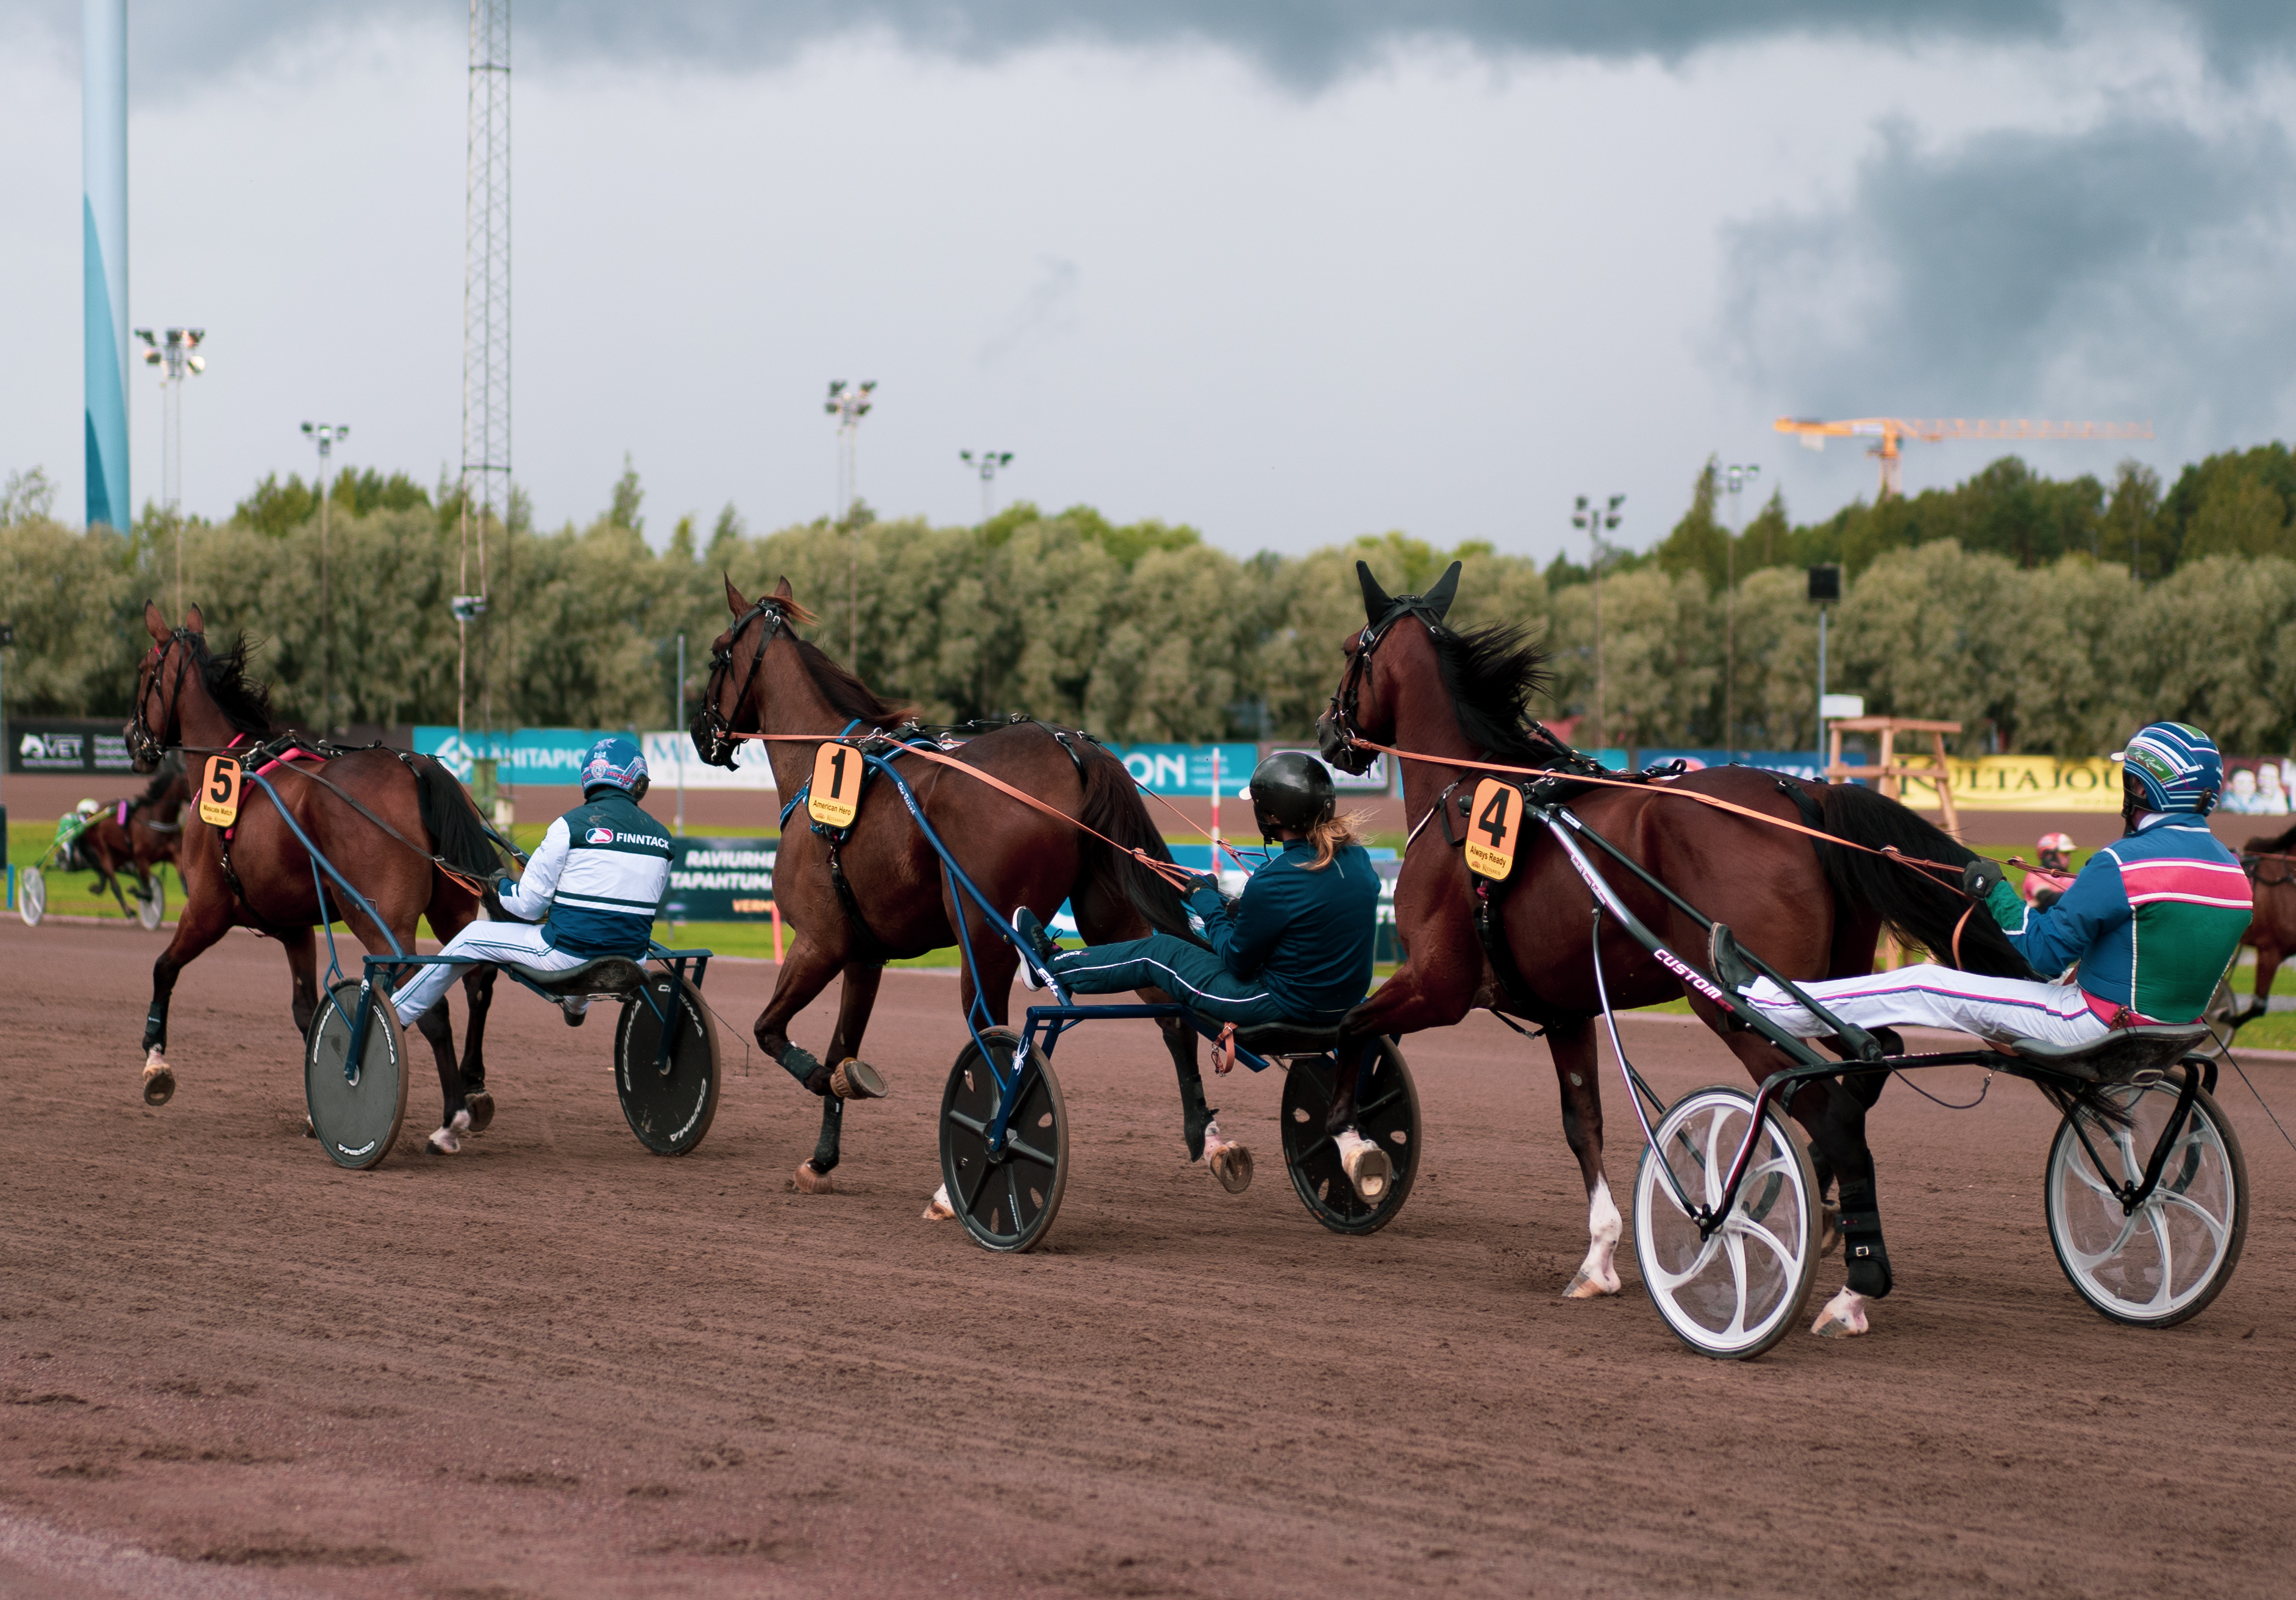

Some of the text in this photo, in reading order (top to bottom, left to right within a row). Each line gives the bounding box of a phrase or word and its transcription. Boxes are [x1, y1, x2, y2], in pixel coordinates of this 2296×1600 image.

[43, 734, 82, 758] VET
[477, 743, 587, 769] ÄHITAPIO
[211, 759, 234, 803] 5
[830, 748, 846, 799] 1
[1122, 752, 1186, 788] ON
[1897, 758, 2124, 796] KLTAJOU
[813, 799, 851, 815] American Hero
[1478, 787, 1511, 848] 4
[616, 832, 669, 849] FINNTACK
[685, 850, 777, 868] RAVIURHE
[1470, 845, 1506, 868] Always Ready
[732, 899, 773, 913] VERM
[1654, 949, 1723, 999] CUSTOM
[658, 984, 703, 1037] CRIMA
[373, 1005, 395, 1064] CORIMA
[623, 999, 642, 1091] CORIMA
[669, 1077, 706, 1141] CORIMA
